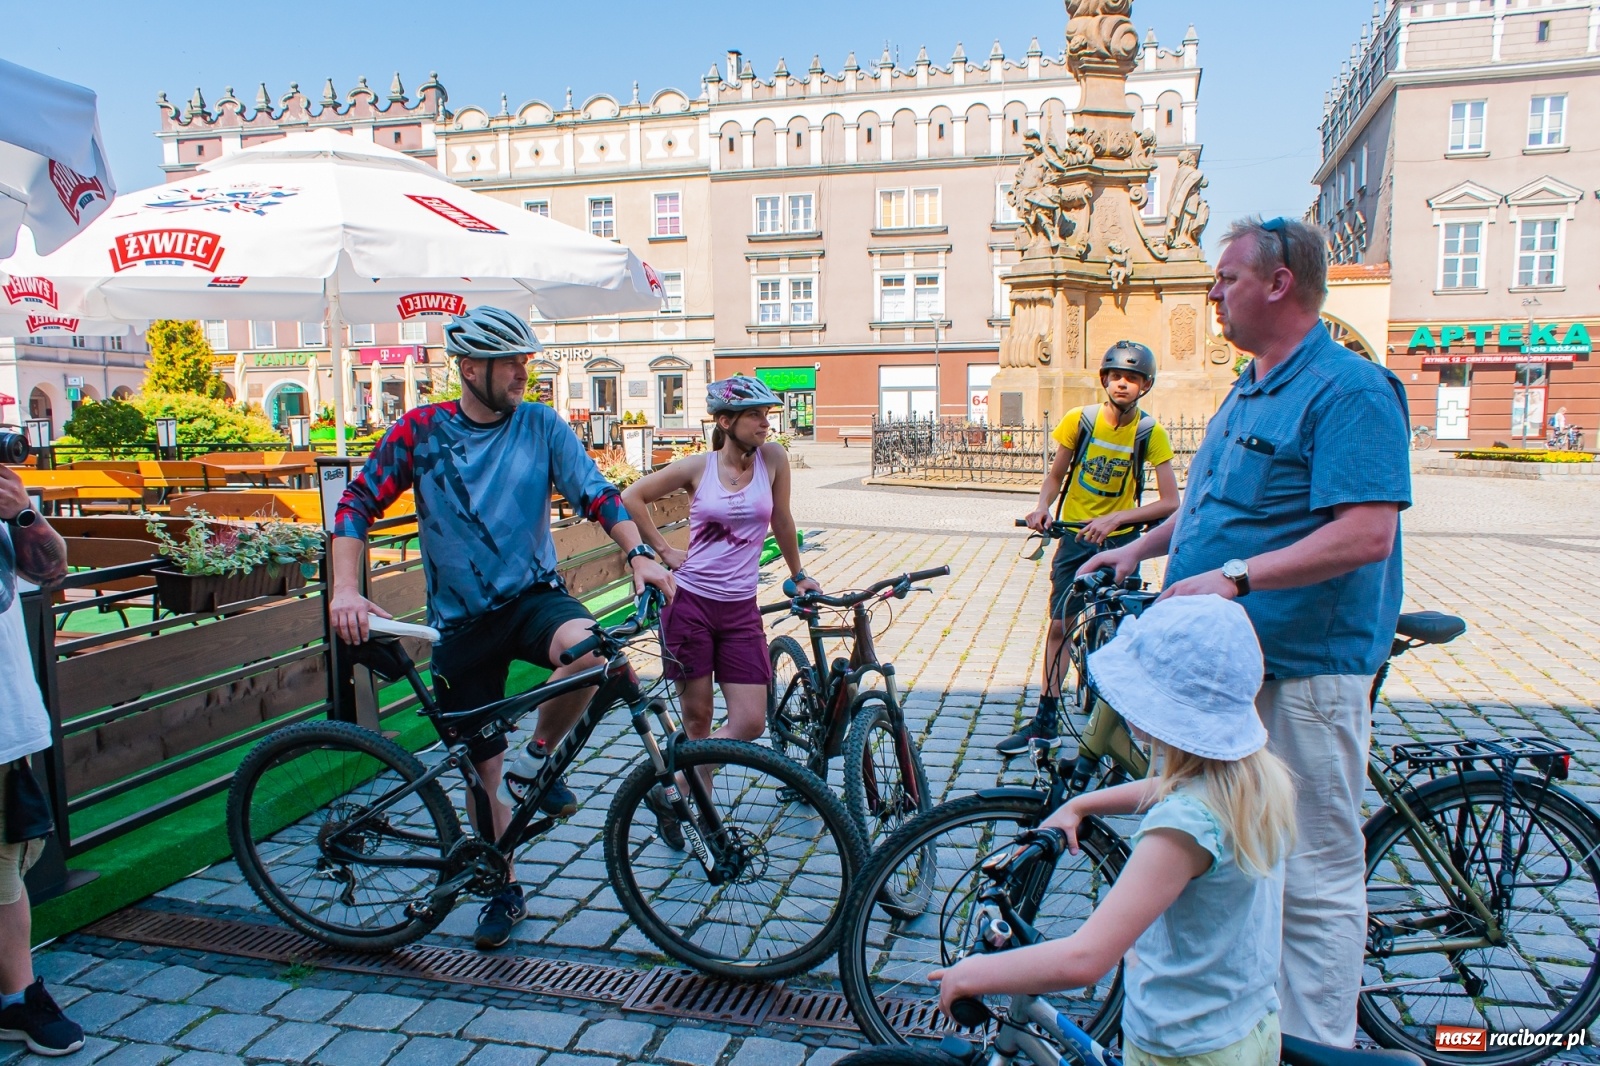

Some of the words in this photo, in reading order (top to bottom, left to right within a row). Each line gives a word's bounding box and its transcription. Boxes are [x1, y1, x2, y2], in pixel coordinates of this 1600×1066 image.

[124, 232, 213, 259] ŻYWIEC
[1408, 323, 1591, 346] APTEKA
[553, 348, 593, 361] SHIRO
[1549, 344, 1589, 352] RÓŻAMI
[764, 372, 808, 384] żabka
